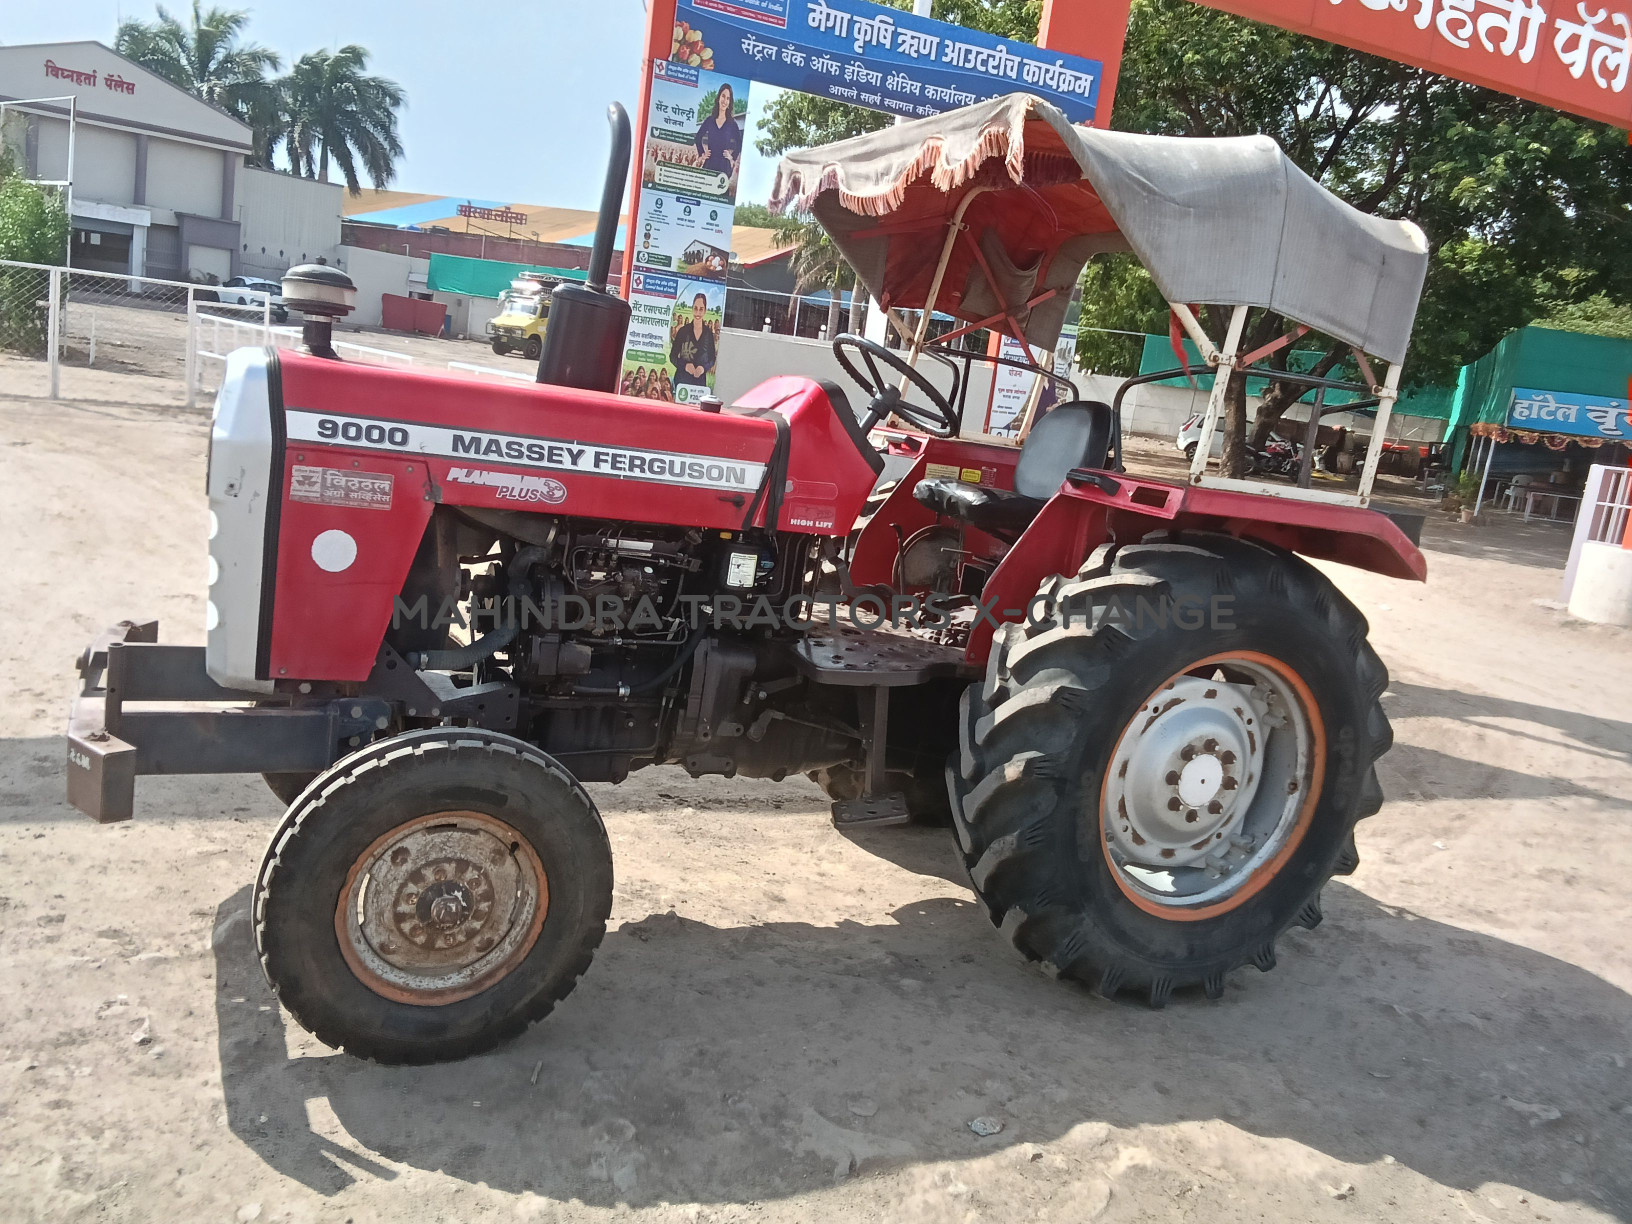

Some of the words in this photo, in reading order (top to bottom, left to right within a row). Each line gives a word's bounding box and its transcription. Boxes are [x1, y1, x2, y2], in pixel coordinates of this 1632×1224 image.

[807, 0, 851, 38] मेगा
[852, 14, 895, 54] कृषि
[896, 27, 940, 61] ऋण
[942, 39, 1021, 79] आउटरीच
[1022, 59, 1094, 97] कार्यक्रम
[1554, 1, 1632, 93] पॅले
[104, 73, 135, 95] पॅलेस
[741, 34, 778, 62] सेंट्रल
[781, 43, 806, 67] बँक
[809, 54, 841, 76] ऑफ
[844, 60, 882, 87] इंडिया
[885, 70, 922, 97] क्षेत्रिय
[924, 84, 976, 106] कार्यालय
[828, 84, 857, 100] आपले
[859, 91, 881, 106] सहर्ष
[883, 97, 914, 113] स्वागत
[1512, 394, 1580, 423] हॉटेल
[1585, 401, 1632, 436] वृं
[317, 419, 409, 447] 9000
[451, 434, 586, 466] MASSEY
[593, 450, 746, 485] FERGUSON
[496, 485, 541, 502] PLUS
[790, 518, 814, 527] HIGH
[815, 520, 833, 529] LIFT
